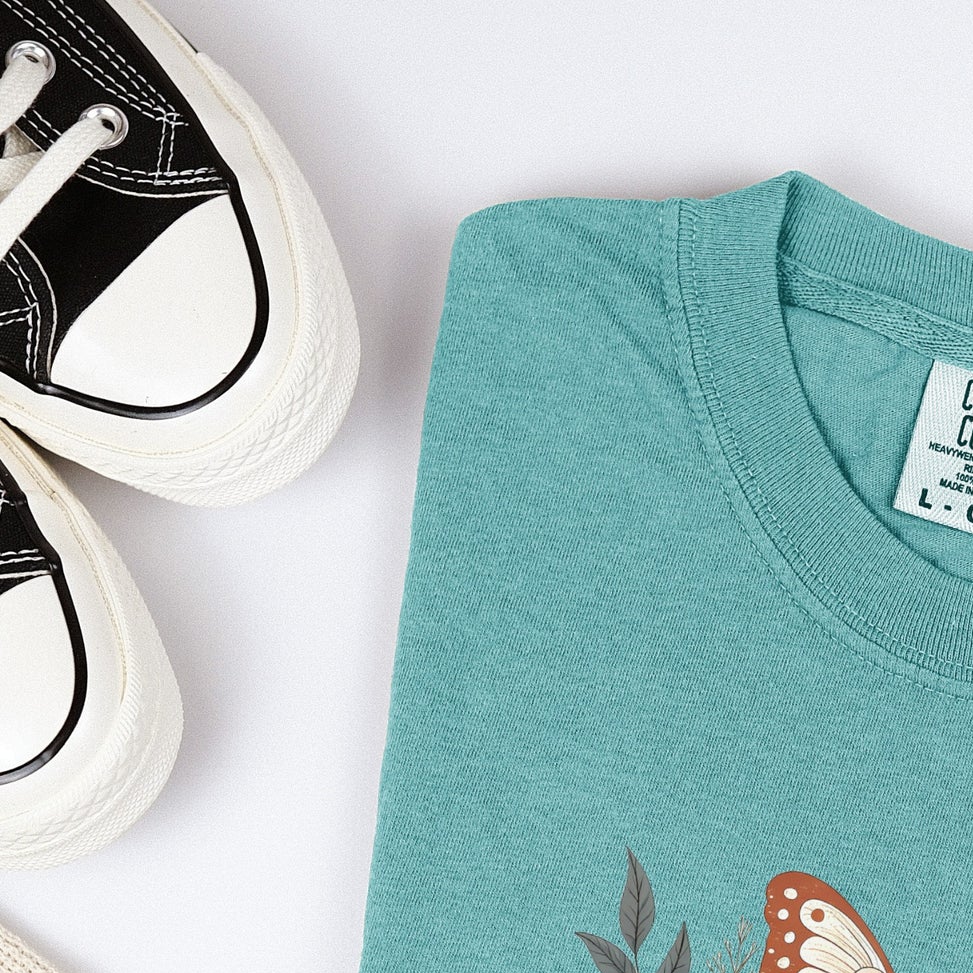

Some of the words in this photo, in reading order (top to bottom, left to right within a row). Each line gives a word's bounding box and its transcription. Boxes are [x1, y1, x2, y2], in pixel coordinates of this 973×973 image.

[939, 478, 964, 493] MADE
[965, 486, 973, 495] IN
[919, 488, 932, 510] L
